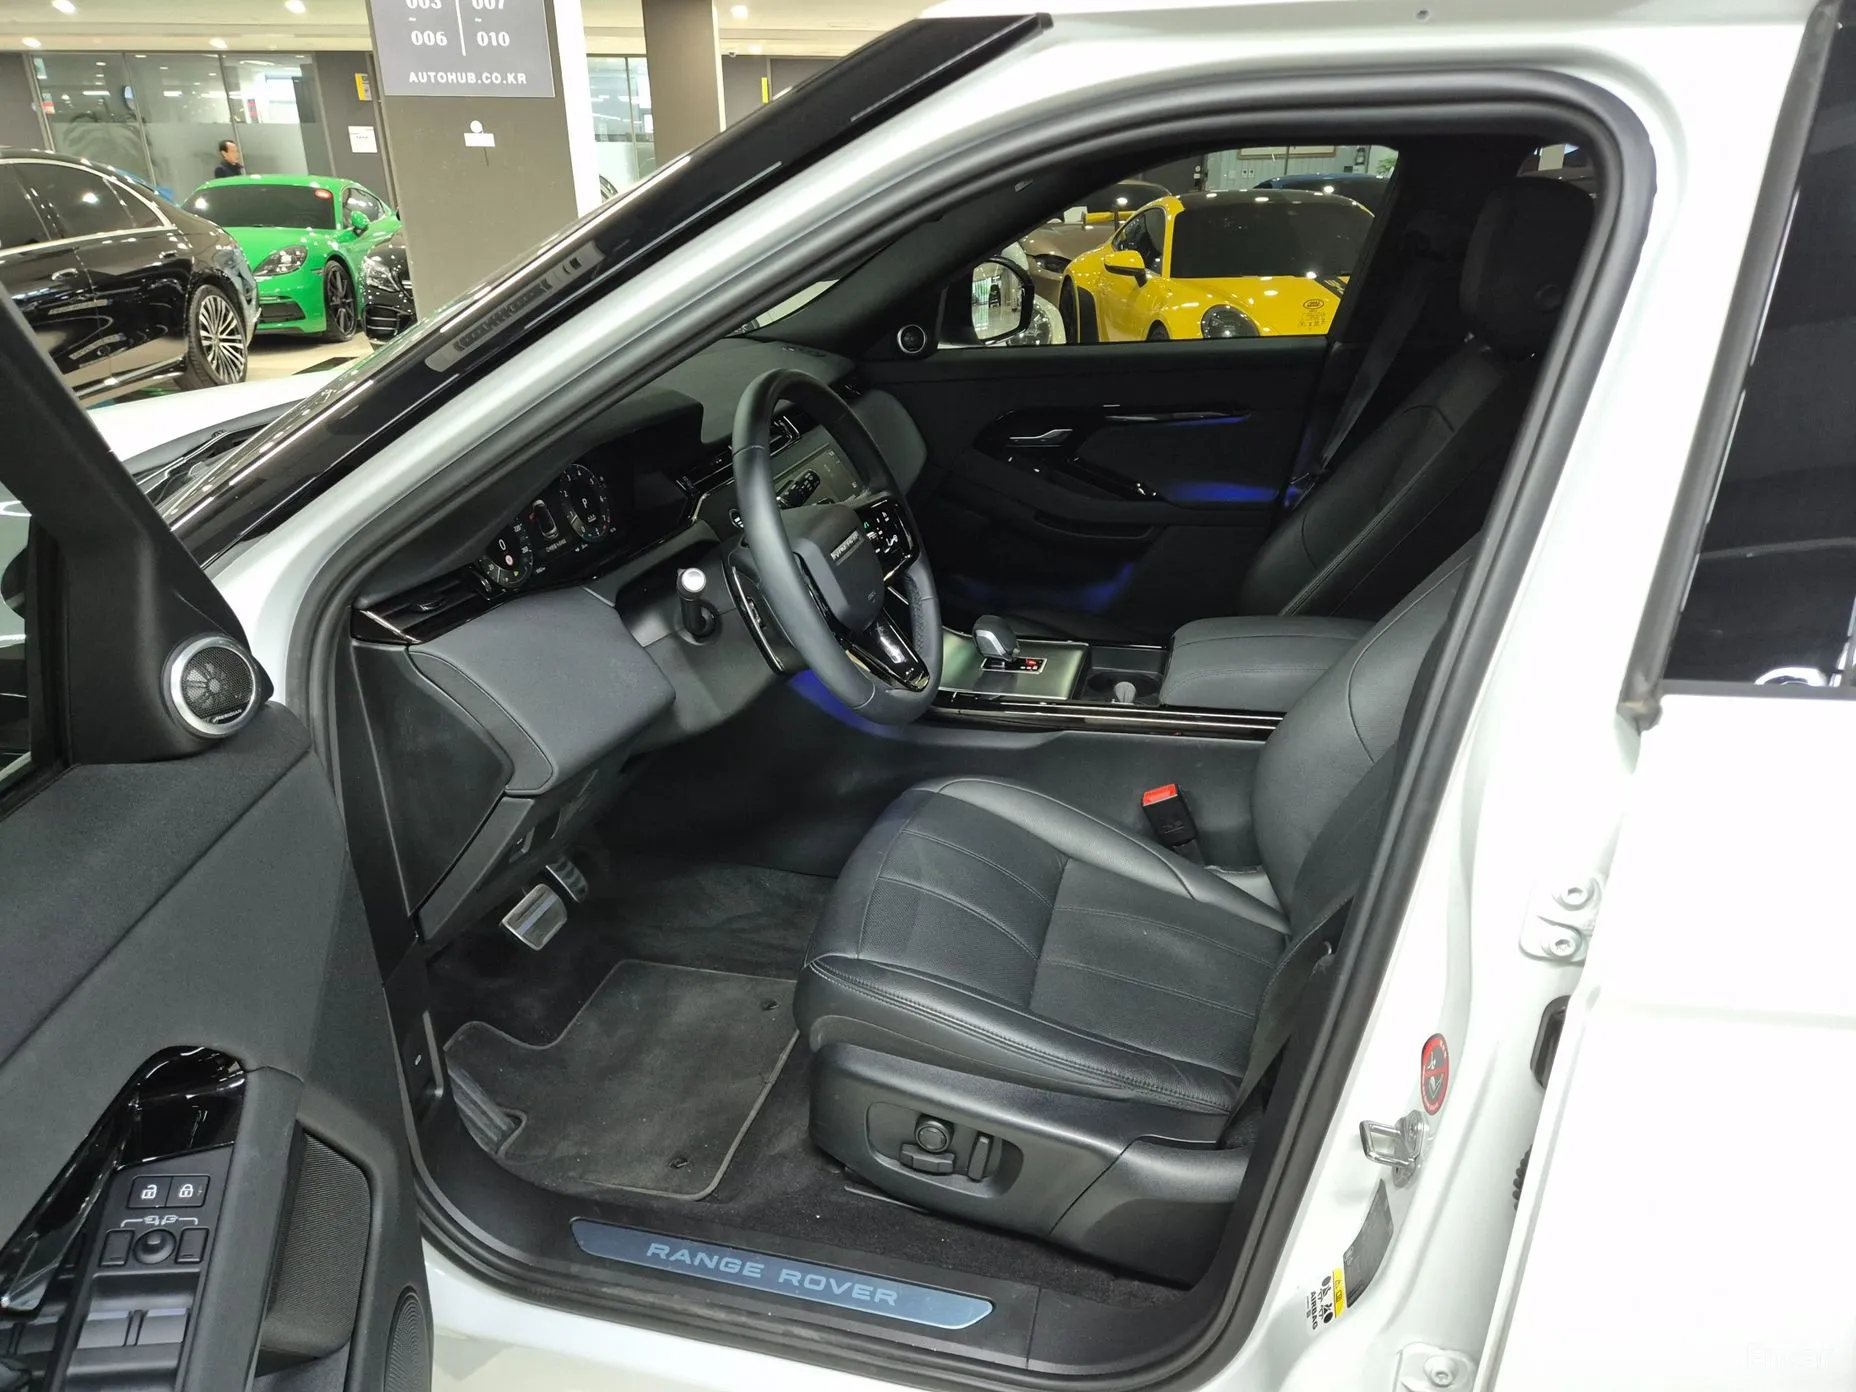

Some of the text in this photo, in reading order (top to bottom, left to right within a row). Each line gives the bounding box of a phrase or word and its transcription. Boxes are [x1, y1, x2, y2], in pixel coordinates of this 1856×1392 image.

[411, 30, 448, 46] 006
[476, 31, 510, 47] 010
[408, 71, 527, 85] AUTOHUB.CO.KR
[646, 1242, 898, 1306] RANGE ROVER
[1310, 1291, 1319, 1330] AIRBAG
